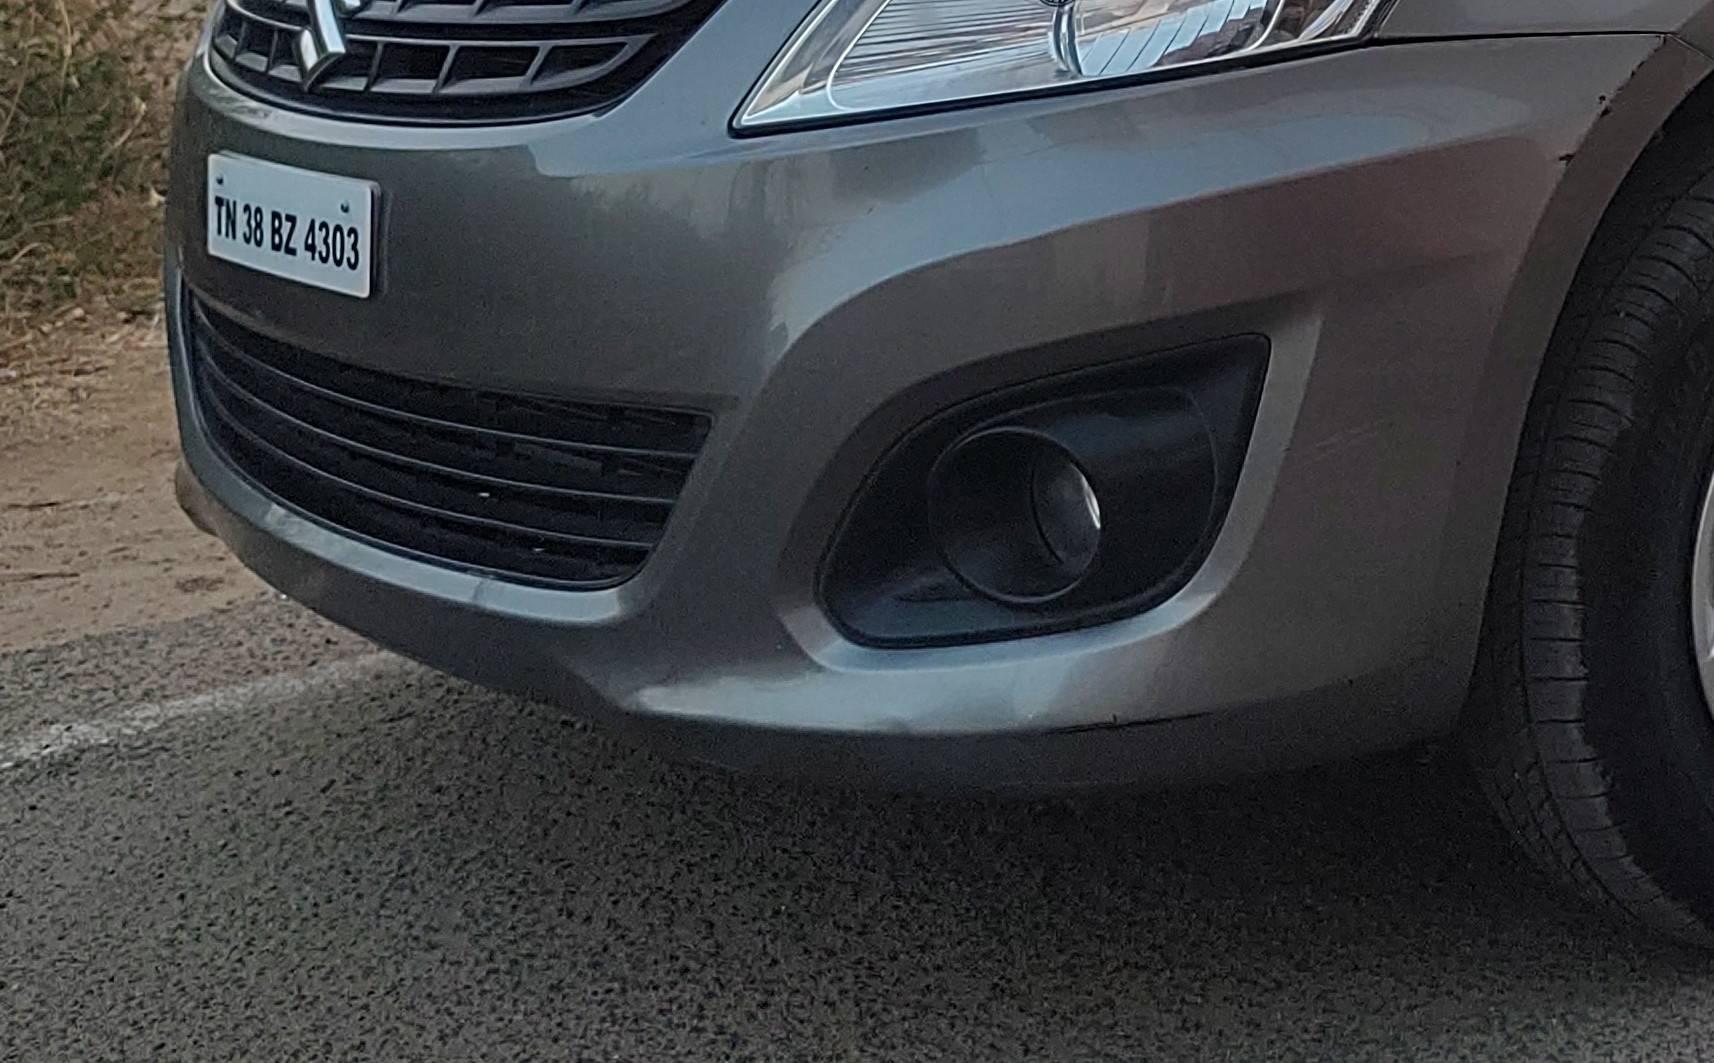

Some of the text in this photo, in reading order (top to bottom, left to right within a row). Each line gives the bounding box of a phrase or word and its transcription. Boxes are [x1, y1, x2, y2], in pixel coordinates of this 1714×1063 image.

[214, 195, 360, 271] TN 38 BZ 4303
